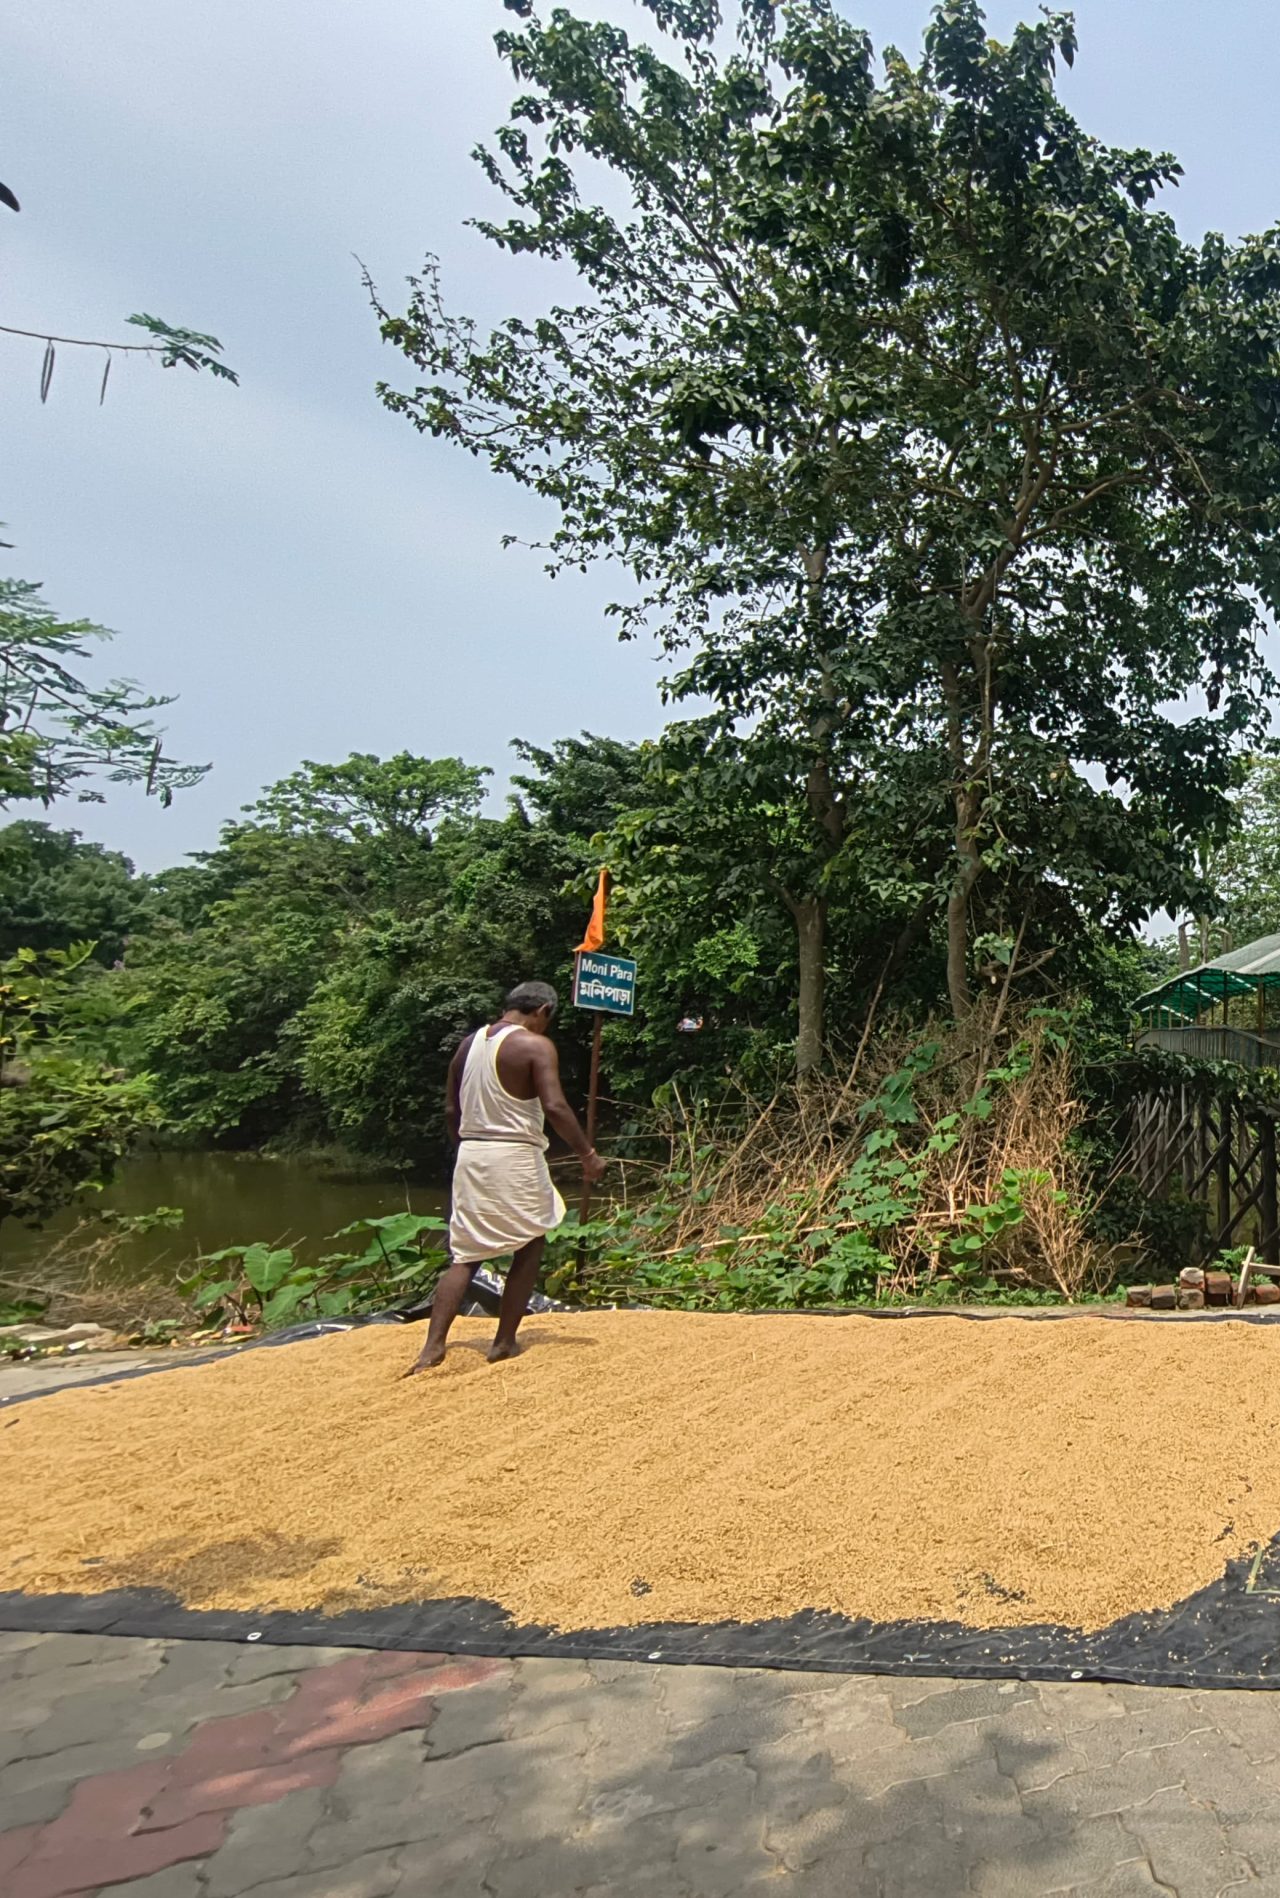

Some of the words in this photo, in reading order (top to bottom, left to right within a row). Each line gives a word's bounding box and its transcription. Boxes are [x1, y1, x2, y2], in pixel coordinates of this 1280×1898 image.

[581, 958, 608, 976] Moni
[610, 965, 633, 981] Para
[580, 978, 631, 1006] মনিপাড়া
